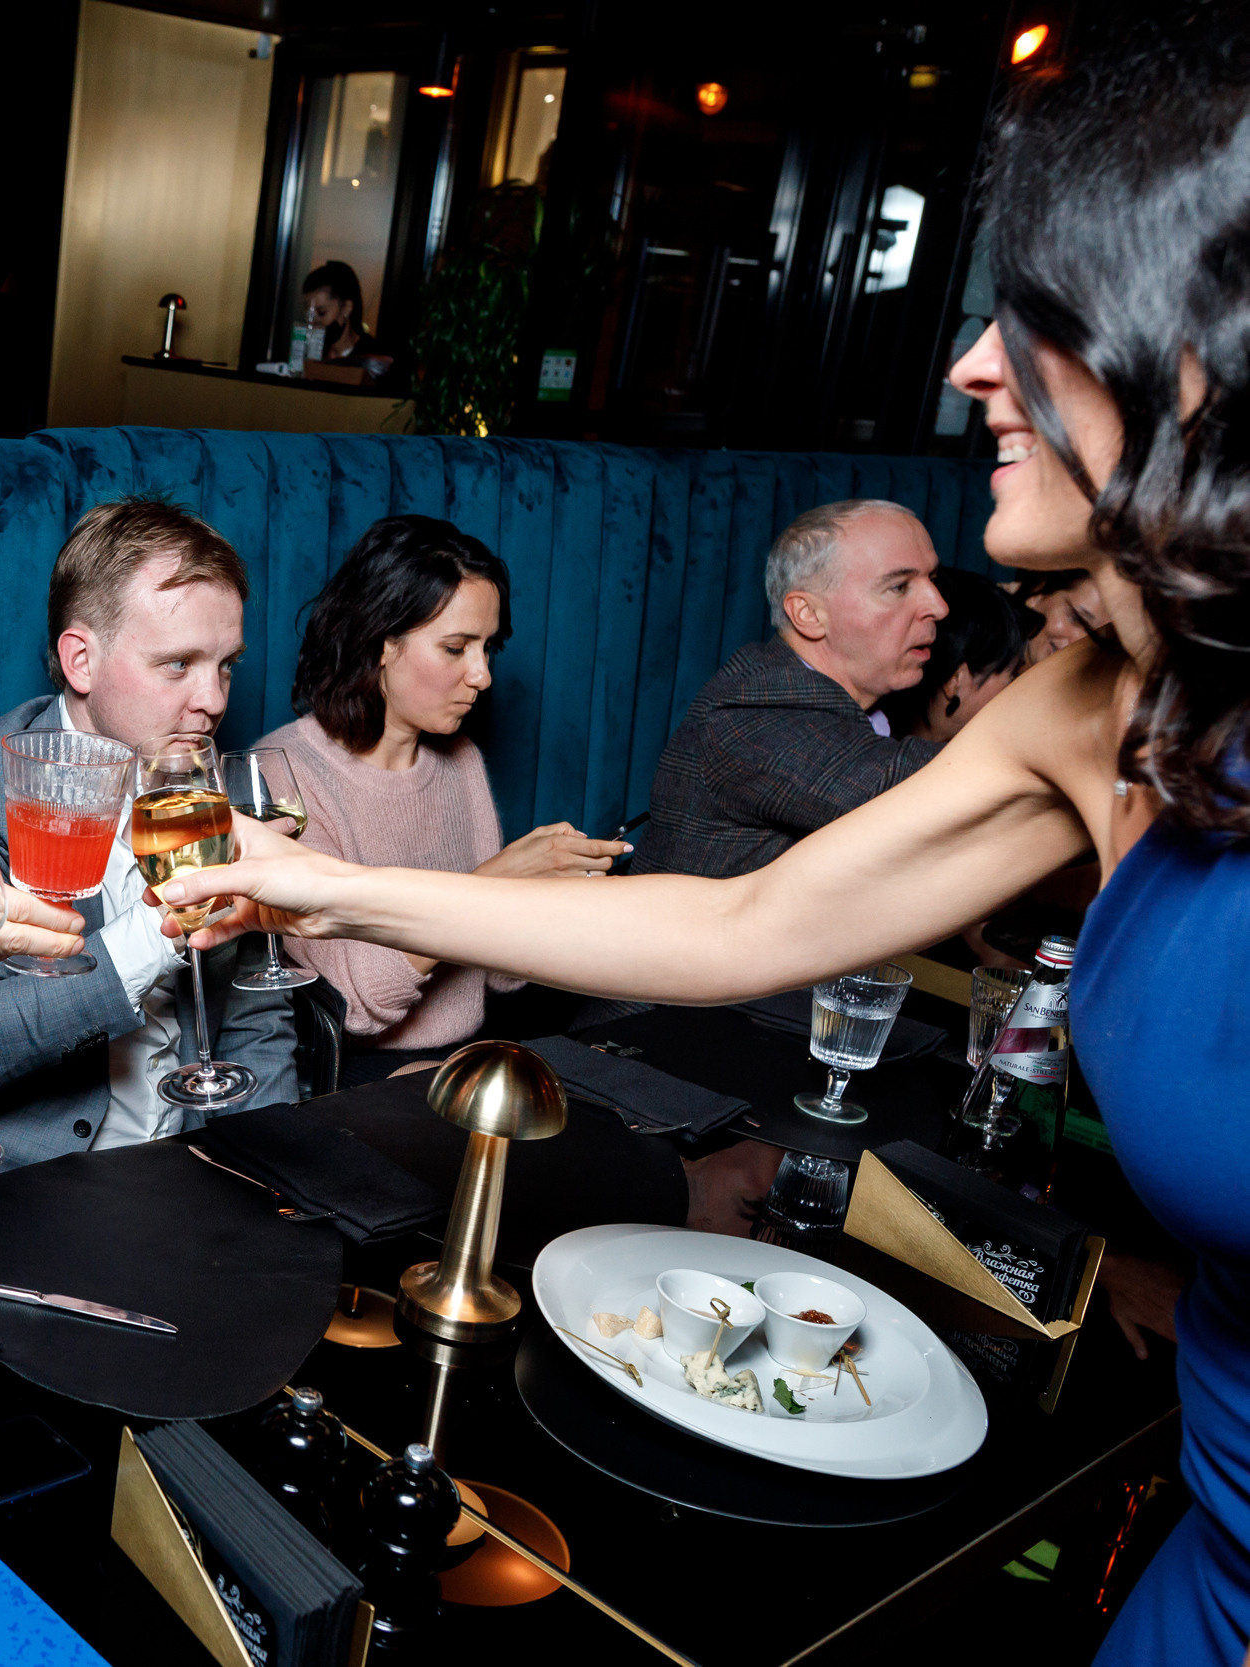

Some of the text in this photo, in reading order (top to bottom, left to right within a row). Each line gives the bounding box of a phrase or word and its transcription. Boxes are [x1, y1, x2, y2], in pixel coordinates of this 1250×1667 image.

[1023, 1003, 1040, 1015] SAN
[973, 1249, 1036, 1281] Влажная
[983, 1264, 1040, 1293] лфетка
